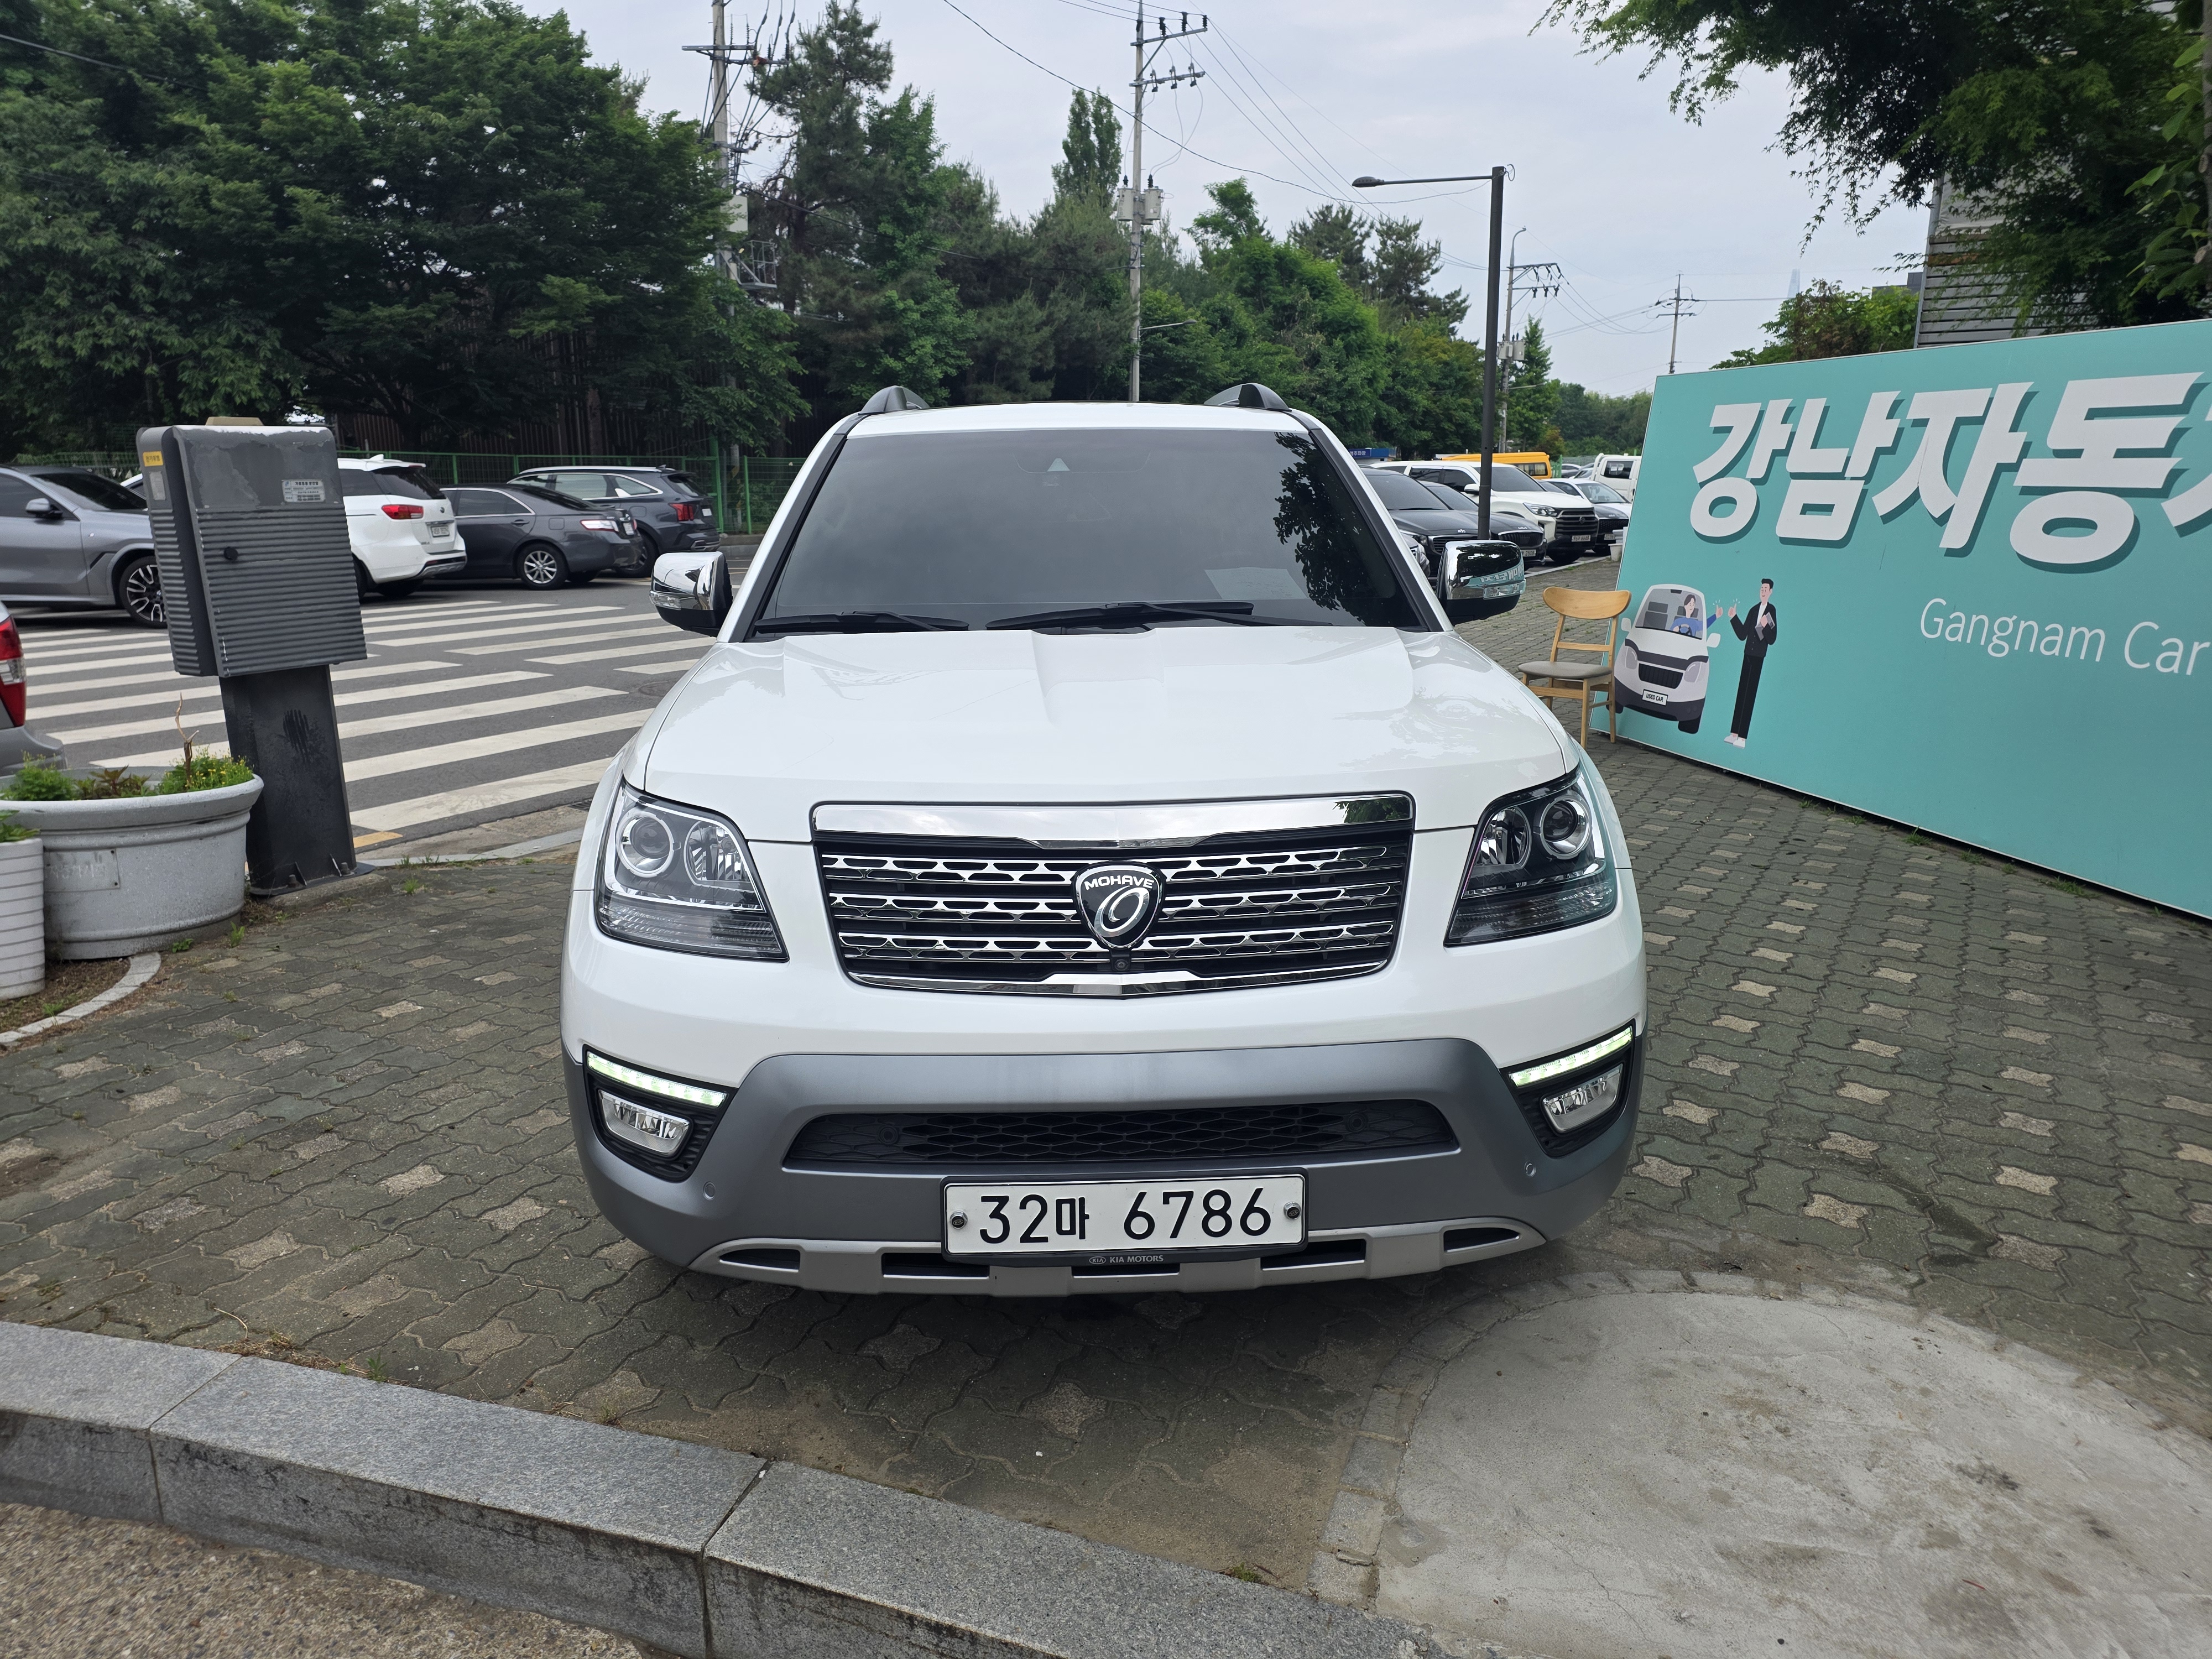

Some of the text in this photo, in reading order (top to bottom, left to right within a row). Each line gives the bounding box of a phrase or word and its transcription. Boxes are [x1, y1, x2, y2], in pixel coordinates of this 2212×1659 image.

[1921, 598, 2211, 675] Gangnam Car
[1084, 875, 1155, 890] MOHAVE
[980, 1188, 1271, 1244] 32마 6786
